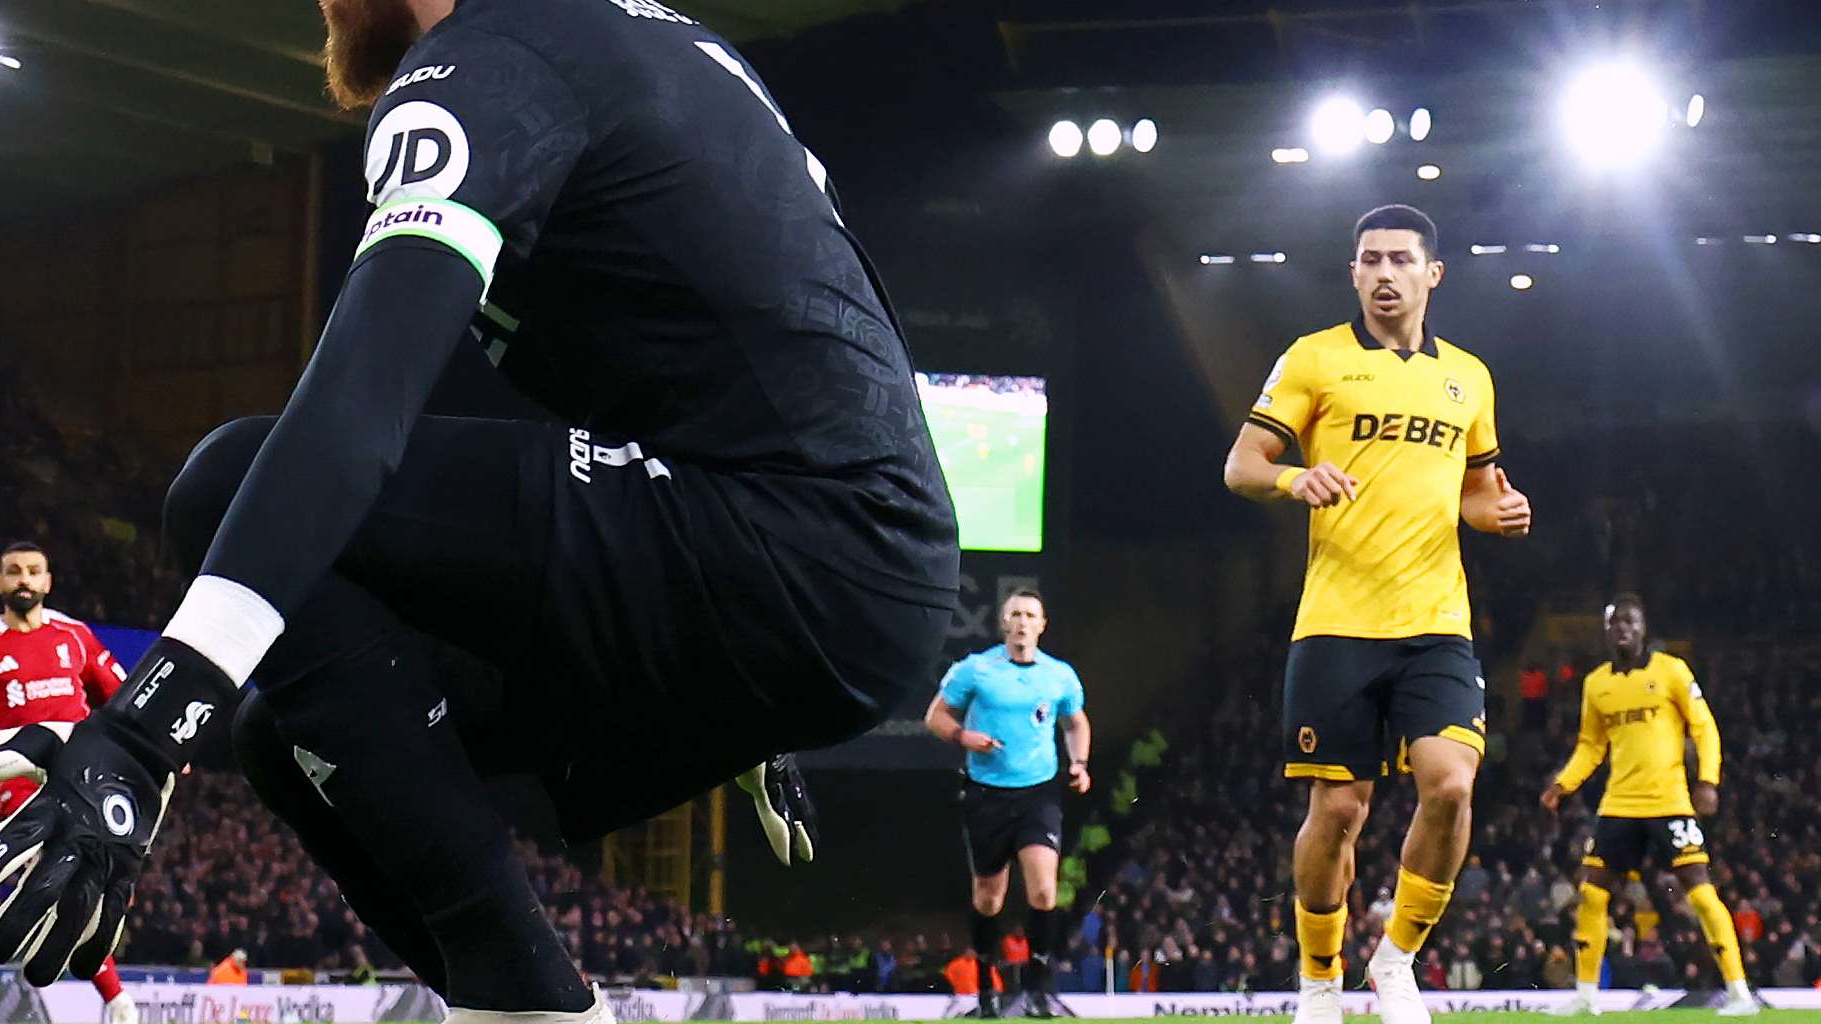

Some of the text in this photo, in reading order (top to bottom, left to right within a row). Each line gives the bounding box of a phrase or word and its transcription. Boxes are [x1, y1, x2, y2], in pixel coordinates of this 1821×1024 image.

[372, 127, 452, 196] JD
[364, 204, 444, 242] ptain
[1351, 413, 1465, 452] DEBET
[1668, 818, 1704, 849] 36
